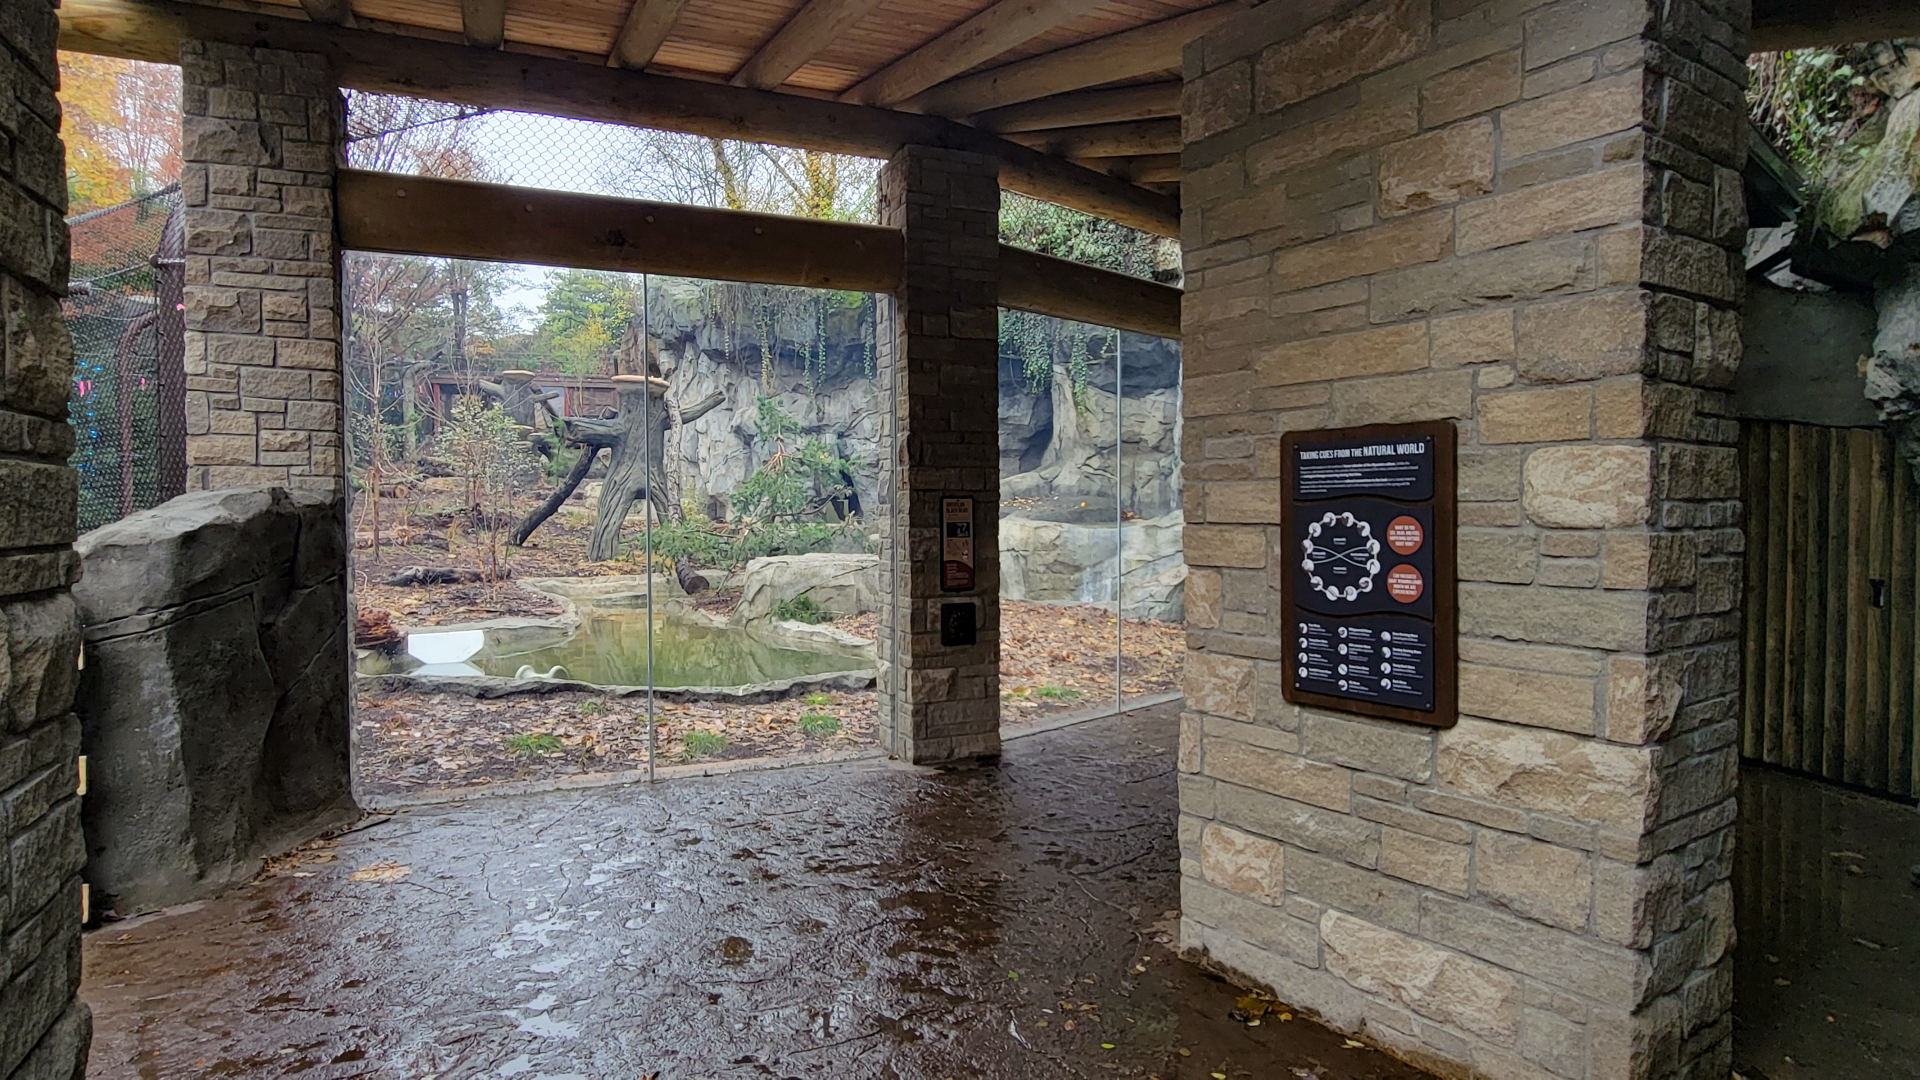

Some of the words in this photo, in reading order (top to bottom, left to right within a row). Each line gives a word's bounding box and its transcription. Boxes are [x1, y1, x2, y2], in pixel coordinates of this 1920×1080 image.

[1300, 451, 1319, 460] TAKING
[1319, 450, 1334, 459] CUES
[1334, 449, 1350, 458] FROM
[1351, 448, 1363, 457] THE
[1363, 444, 1396, 456] NATURAL
[1396, 442, 1425, 455] WORLD
